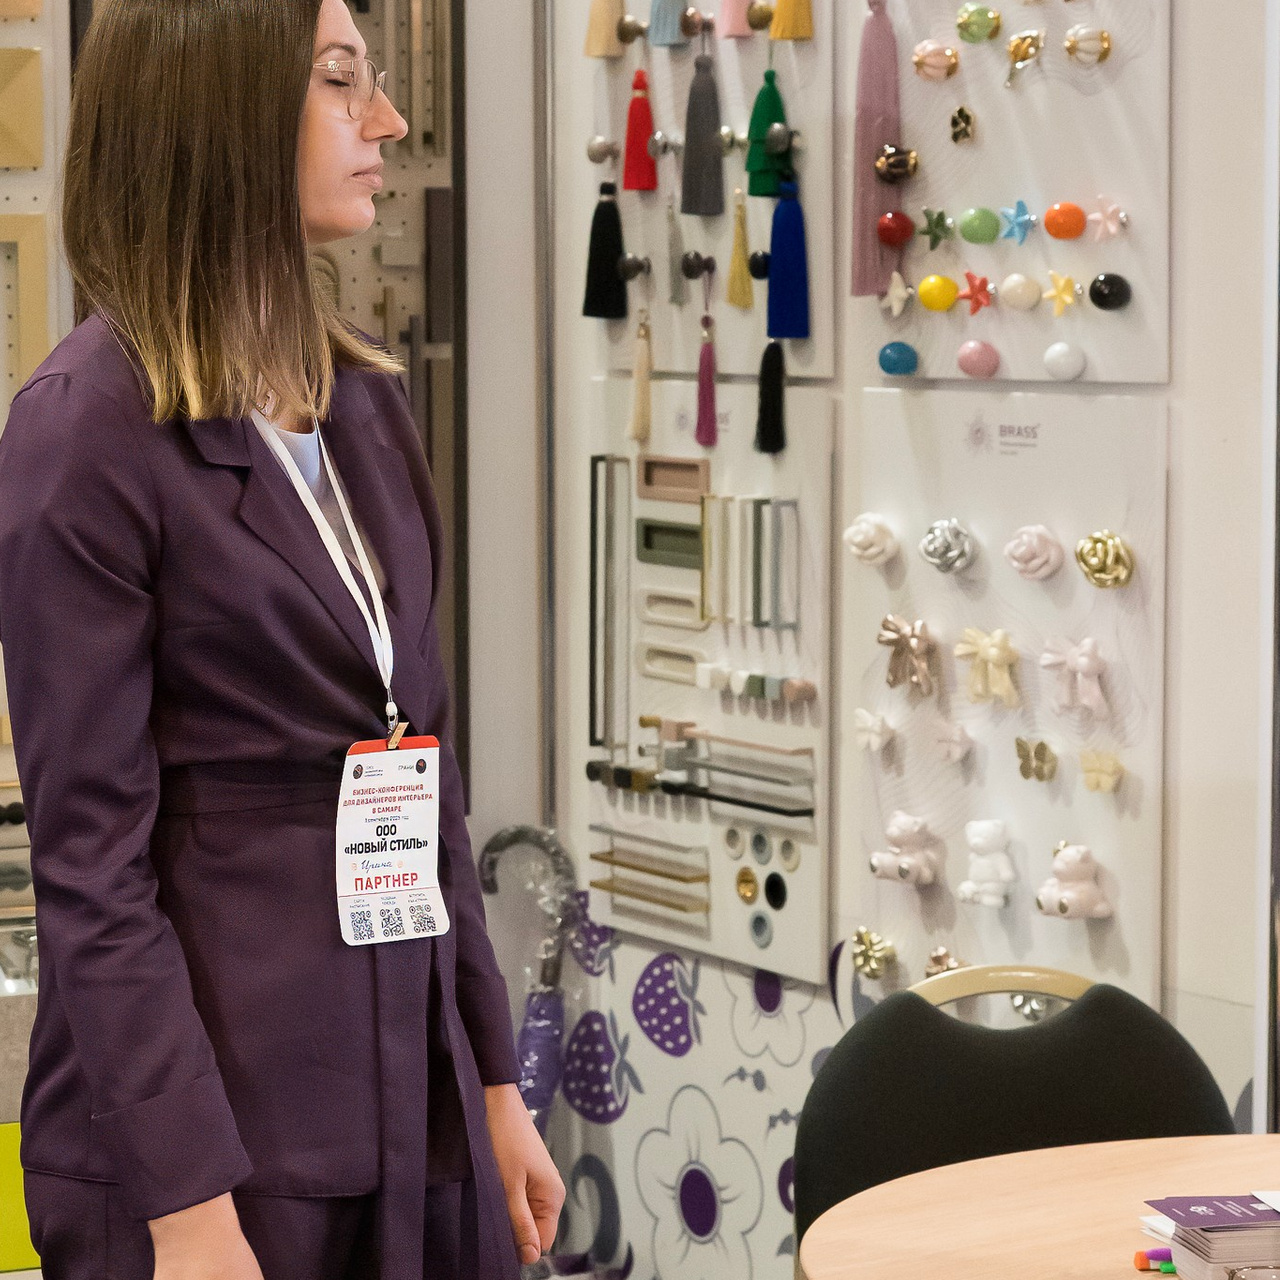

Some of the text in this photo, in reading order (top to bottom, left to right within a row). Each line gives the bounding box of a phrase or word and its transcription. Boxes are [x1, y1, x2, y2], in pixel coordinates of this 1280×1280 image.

[999, 424, 1038, 439] BRASS
[343, 793, 433, 807] ДЛЯ ДИЗАЙНЕРОВ ИНТЕРЬЕРА
[377, 805, 402, 814] САМАРЕ
[376, 824, 397, 837] ООО
[344, 838, 428, 855] «НОВЫЙ СТИЛЬ»
[354, 872, 419, 891] ПАРТНЕР
